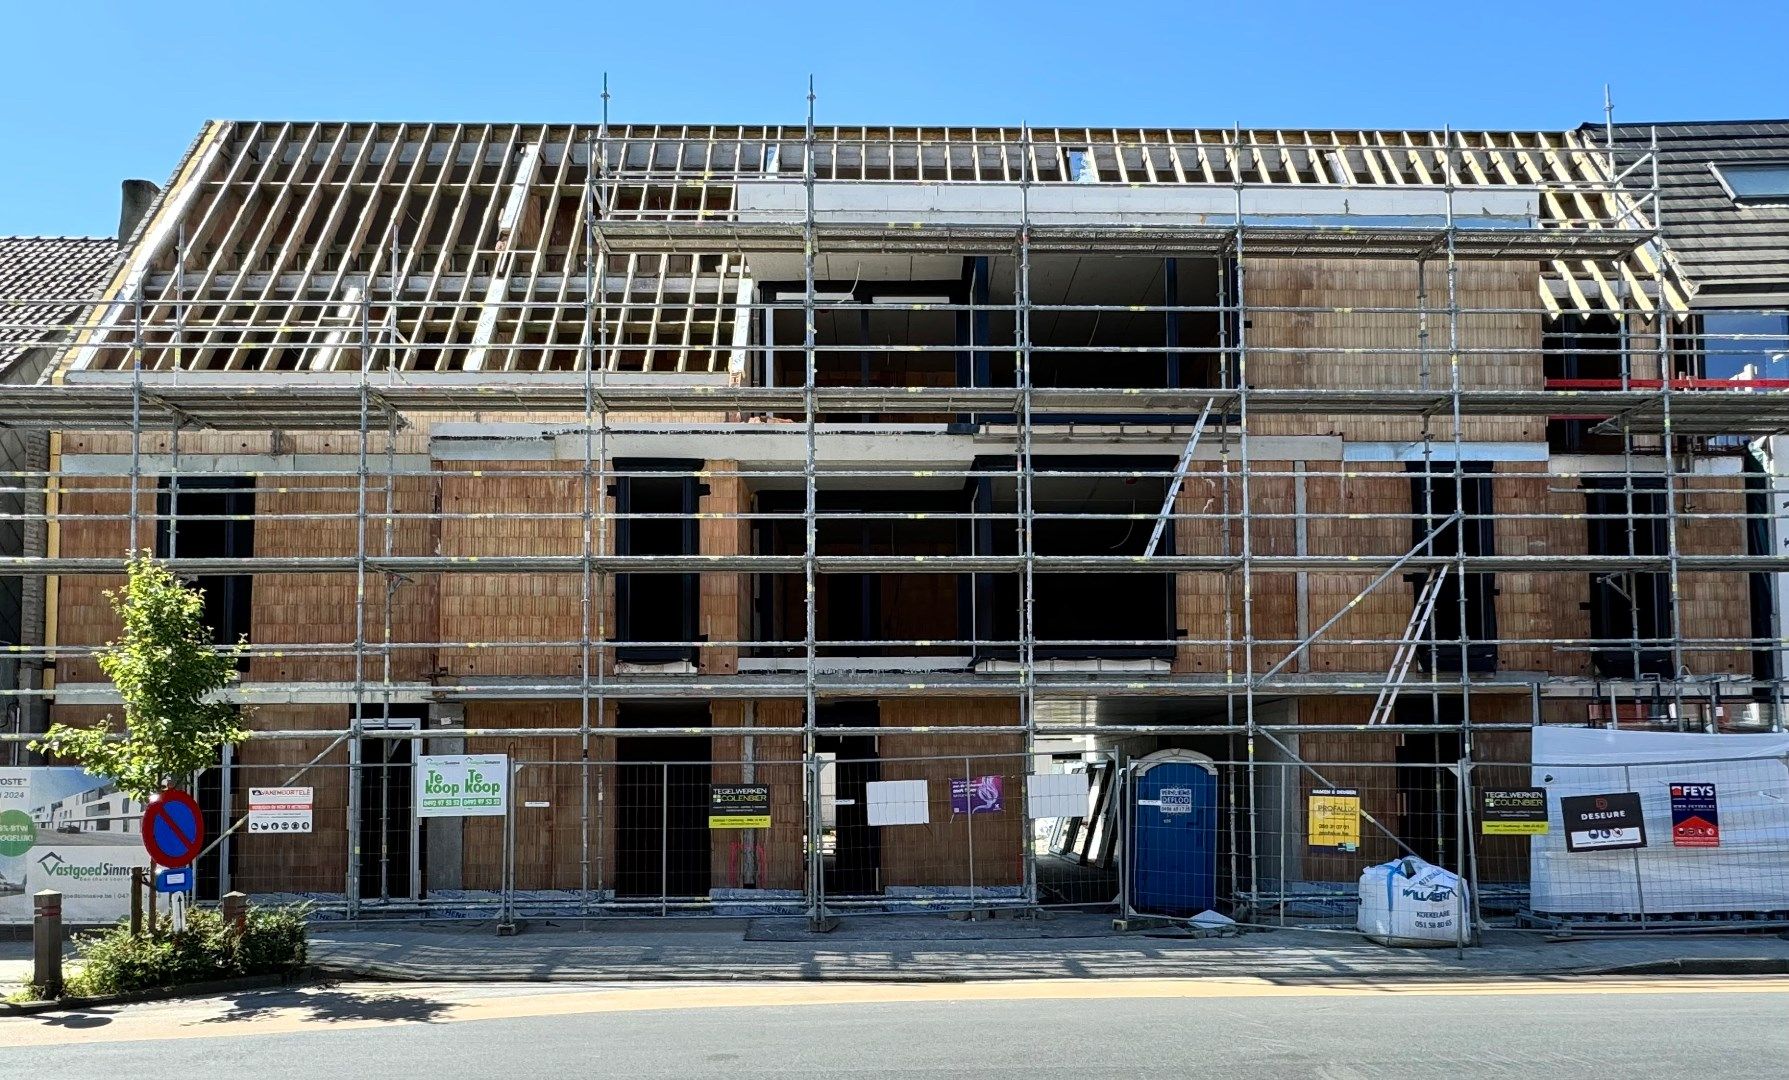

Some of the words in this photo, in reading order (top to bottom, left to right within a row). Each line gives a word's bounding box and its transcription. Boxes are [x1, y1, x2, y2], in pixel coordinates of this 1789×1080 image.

[428, 769, 443, 785] Te
[467, 769, 483, 783] Te
[425, 780, 460, 796] koop
[464, 778, 501, 796] koop
[1682, 785, 1715, 797] FEYS
[3, 791, 25, 799] 2024
[1161, 796, 1190, 805] DEFLOO
[1484, 791, 1544, 799] TEGELWERKEN
[1494, 798, 1544, 807] COLENBIER
[1580, 810, 1627, 821] DESEURE
[1403, 888, 1451, 902] WILLAERT
[1414, 920, 1428, 929] 051
